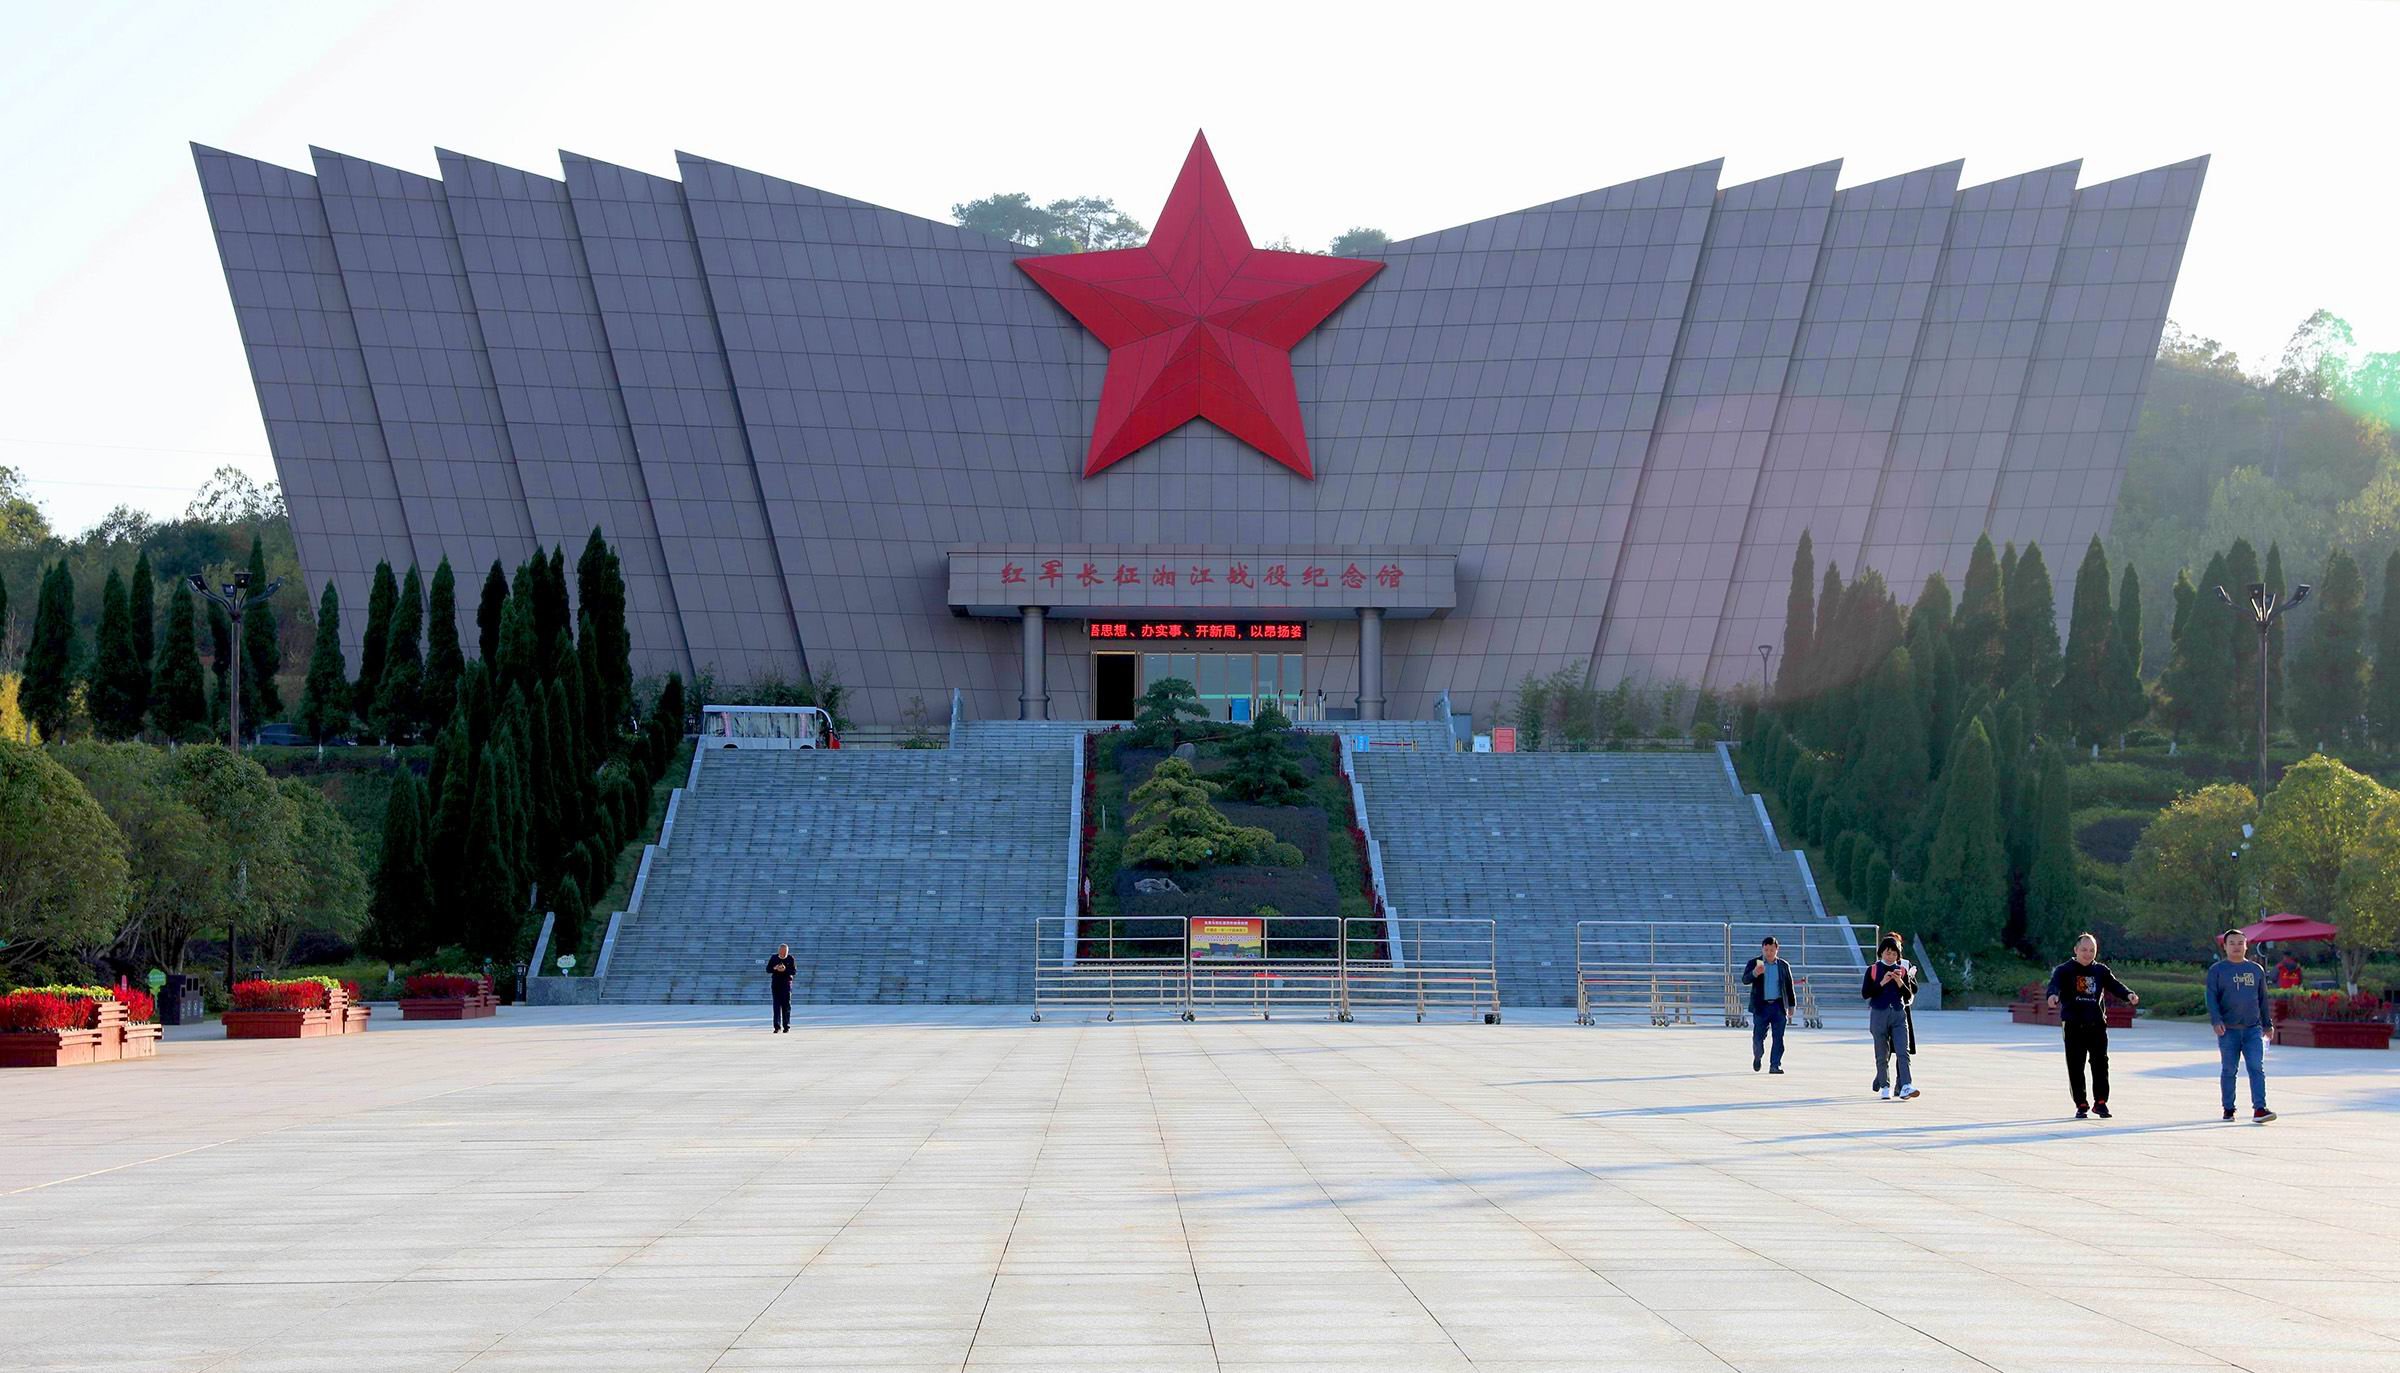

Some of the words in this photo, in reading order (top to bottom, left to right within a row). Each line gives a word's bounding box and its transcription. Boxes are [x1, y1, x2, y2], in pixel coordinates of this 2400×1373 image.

[1001, 560, 1404, 589] 红军长征湘江战役纪念馆
